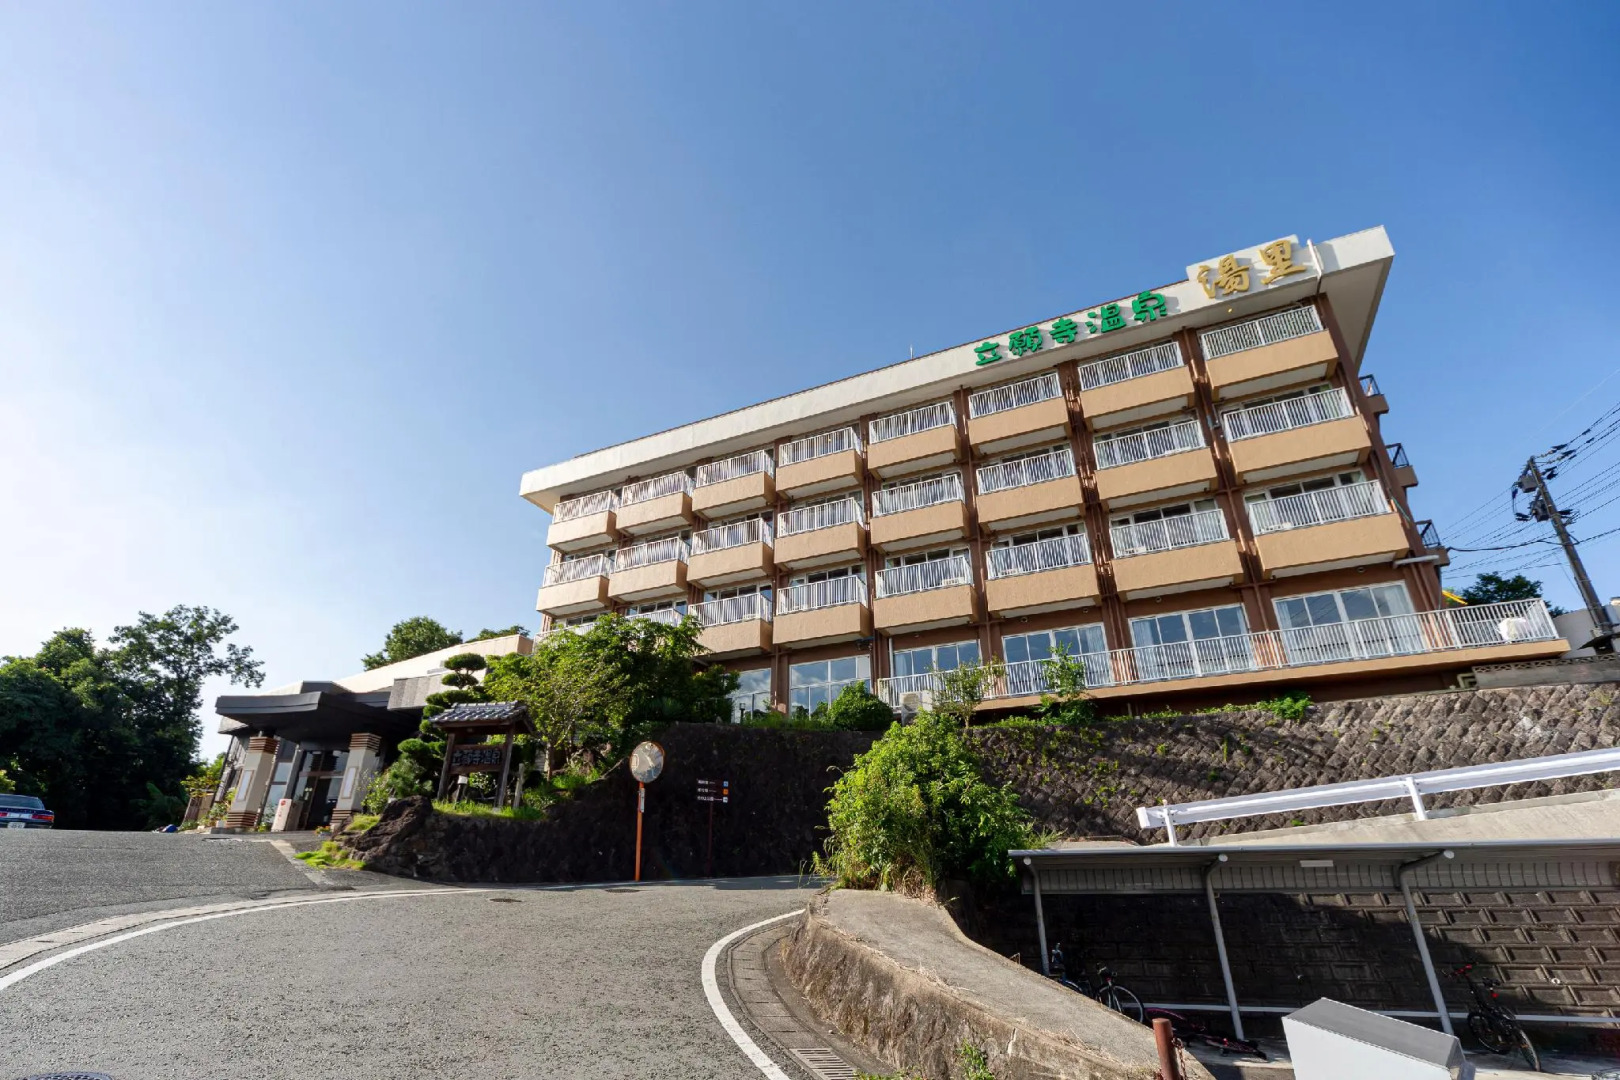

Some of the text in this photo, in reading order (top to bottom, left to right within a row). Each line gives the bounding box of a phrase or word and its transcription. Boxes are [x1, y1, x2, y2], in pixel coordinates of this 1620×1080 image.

[1197, 239, 1307, 299] 湯里
[974, 290, 1168, 366] 立願寺温泉
